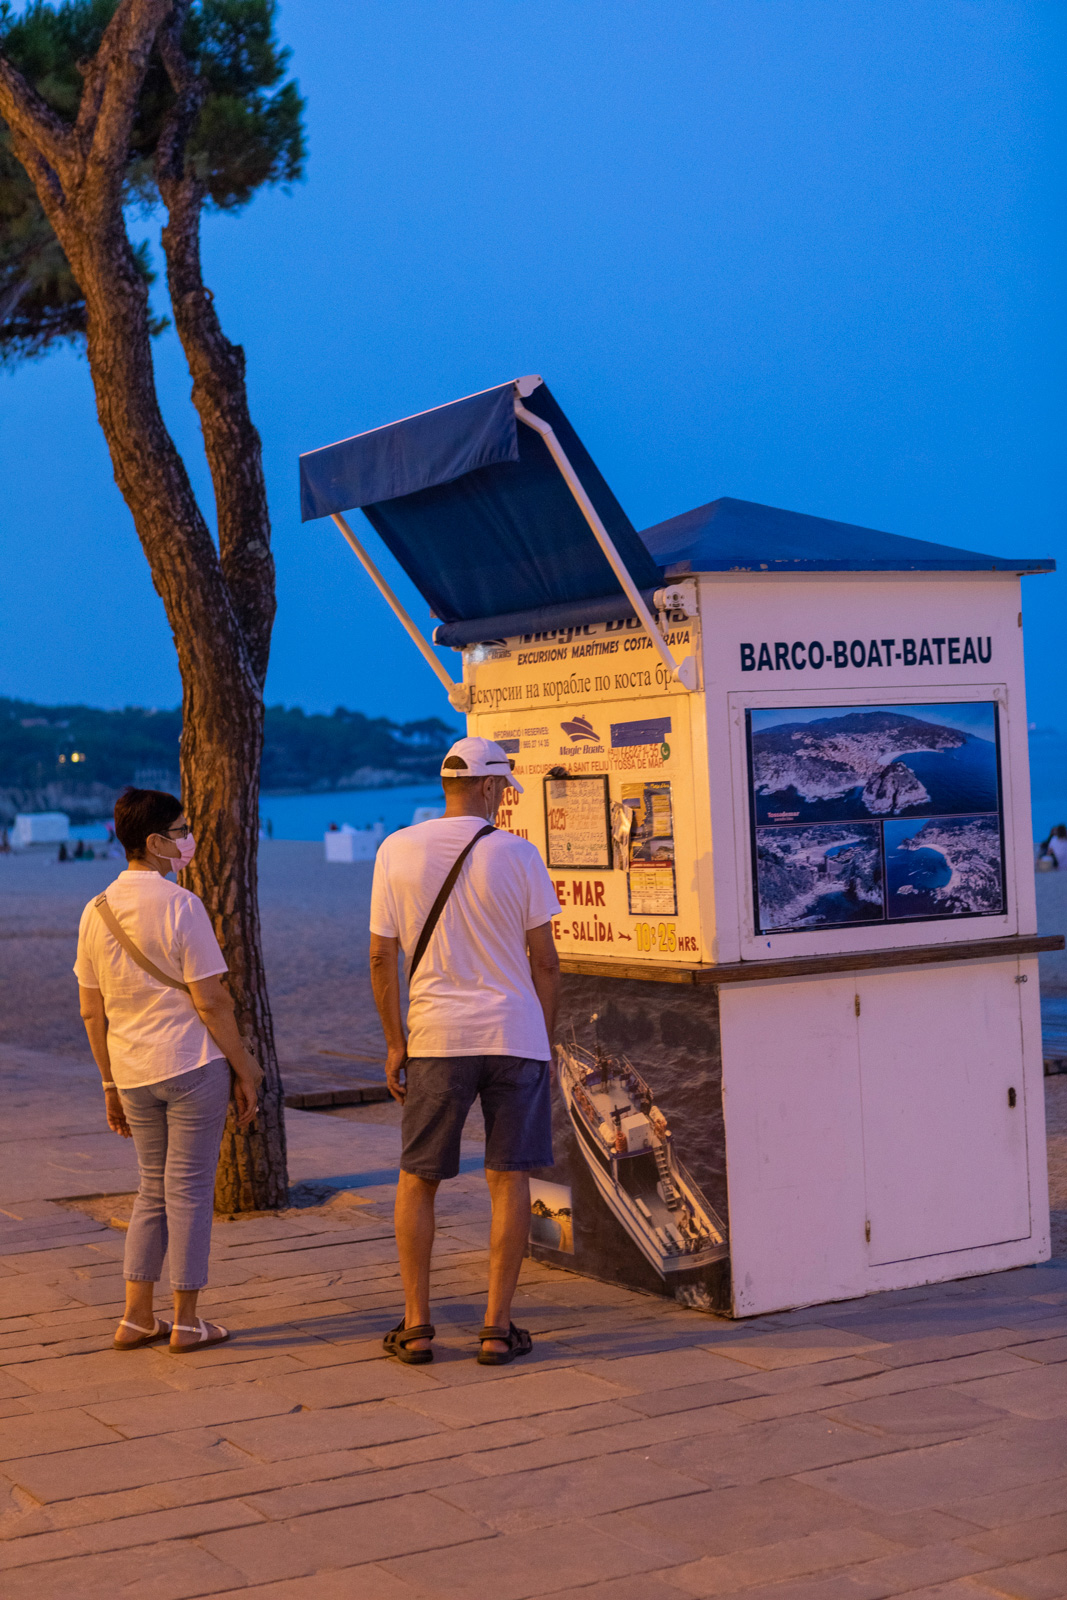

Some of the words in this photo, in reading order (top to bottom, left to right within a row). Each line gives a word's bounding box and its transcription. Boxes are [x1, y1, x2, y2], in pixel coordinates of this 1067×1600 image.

[517, 647, 568, 666] EXCURSIONS
[571, 640, 620, 659] MARÍTIMES
[623, 635, 654, 652] COSTA
[662, 630, 690, 647] RAVA
[739, 636, 992, 671] BARCO-BOAT-BATEAU
[525, 683, 540, 699] на
[542, 672, 592, 702] корабле
[594, 675, 611, 692] по
[614, 669, 652, 690] коста
[559, 745, 582, 757] Magic
[583, 744, 605, 755] Boats
[574, 761, 590, 773] SANT
[591, 760, 609, 772] FELIU
[613, 759, 636, 771] TOSSA
[637, 758, 647, 769] DE
[648, 756, 665, 769] MAR
[551, 914, 614, 942] E-SALÍDA
[634, 922, 677, 952] 10:25
[678, 936, 699, 951] HRS.
